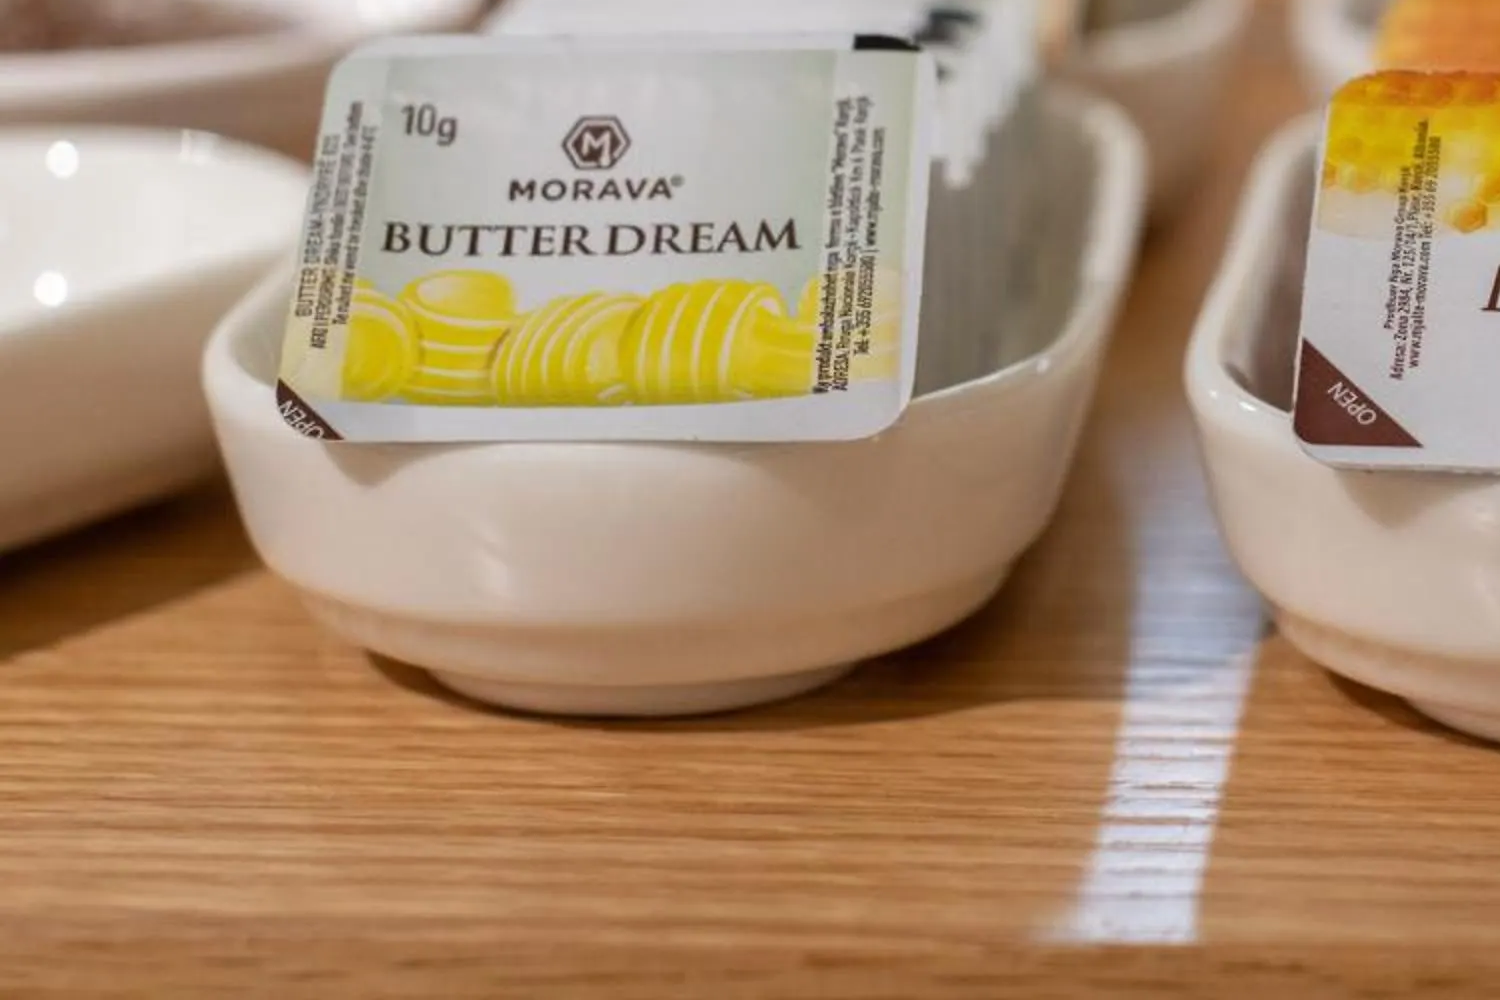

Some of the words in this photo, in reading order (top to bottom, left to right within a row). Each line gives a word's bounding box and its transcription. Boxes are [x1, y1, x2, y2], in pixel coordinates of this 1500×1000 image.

[399, 104, 458, 146] 10g
[381, 220, 604, 257] BUTTER
[608, 217, 801, 256] DREAM
[1393, 315, 1407, 340] Zona
[1327, 382, 1376, 425] OPEN
